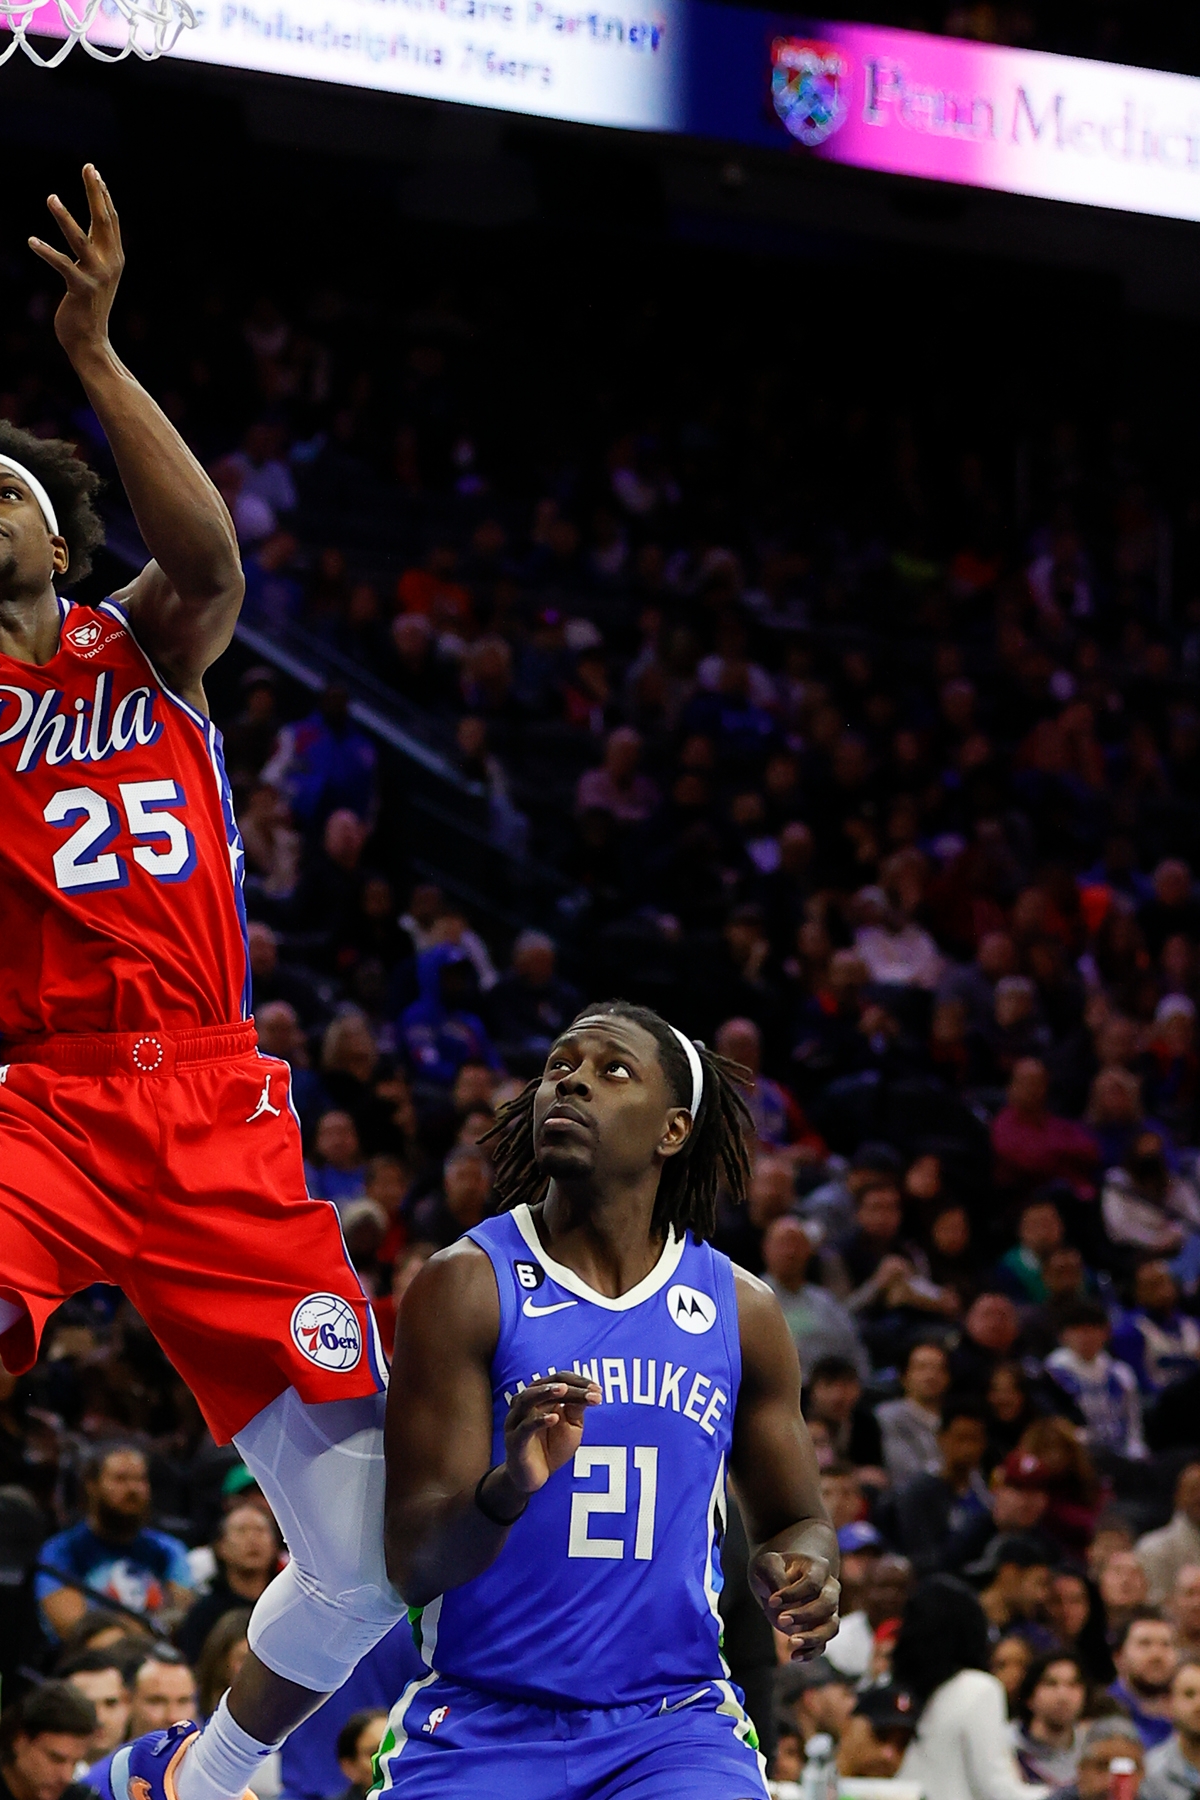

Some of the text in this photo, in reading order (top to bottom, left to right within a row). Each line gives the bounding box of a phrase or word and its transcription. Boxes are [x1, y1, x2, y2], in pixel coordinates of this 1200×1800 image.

[221, 3, 443, 66] Philadelphia
[458, 42, 552, 88] 76ers
[863, 56, 997, 141] Penn
[43, 779, 198, 896] 25
[516, 1262, 539, 1289] 6
[301, 1324, 359, 1352] 76ers
[568, 1446, 658, 1560] 21
